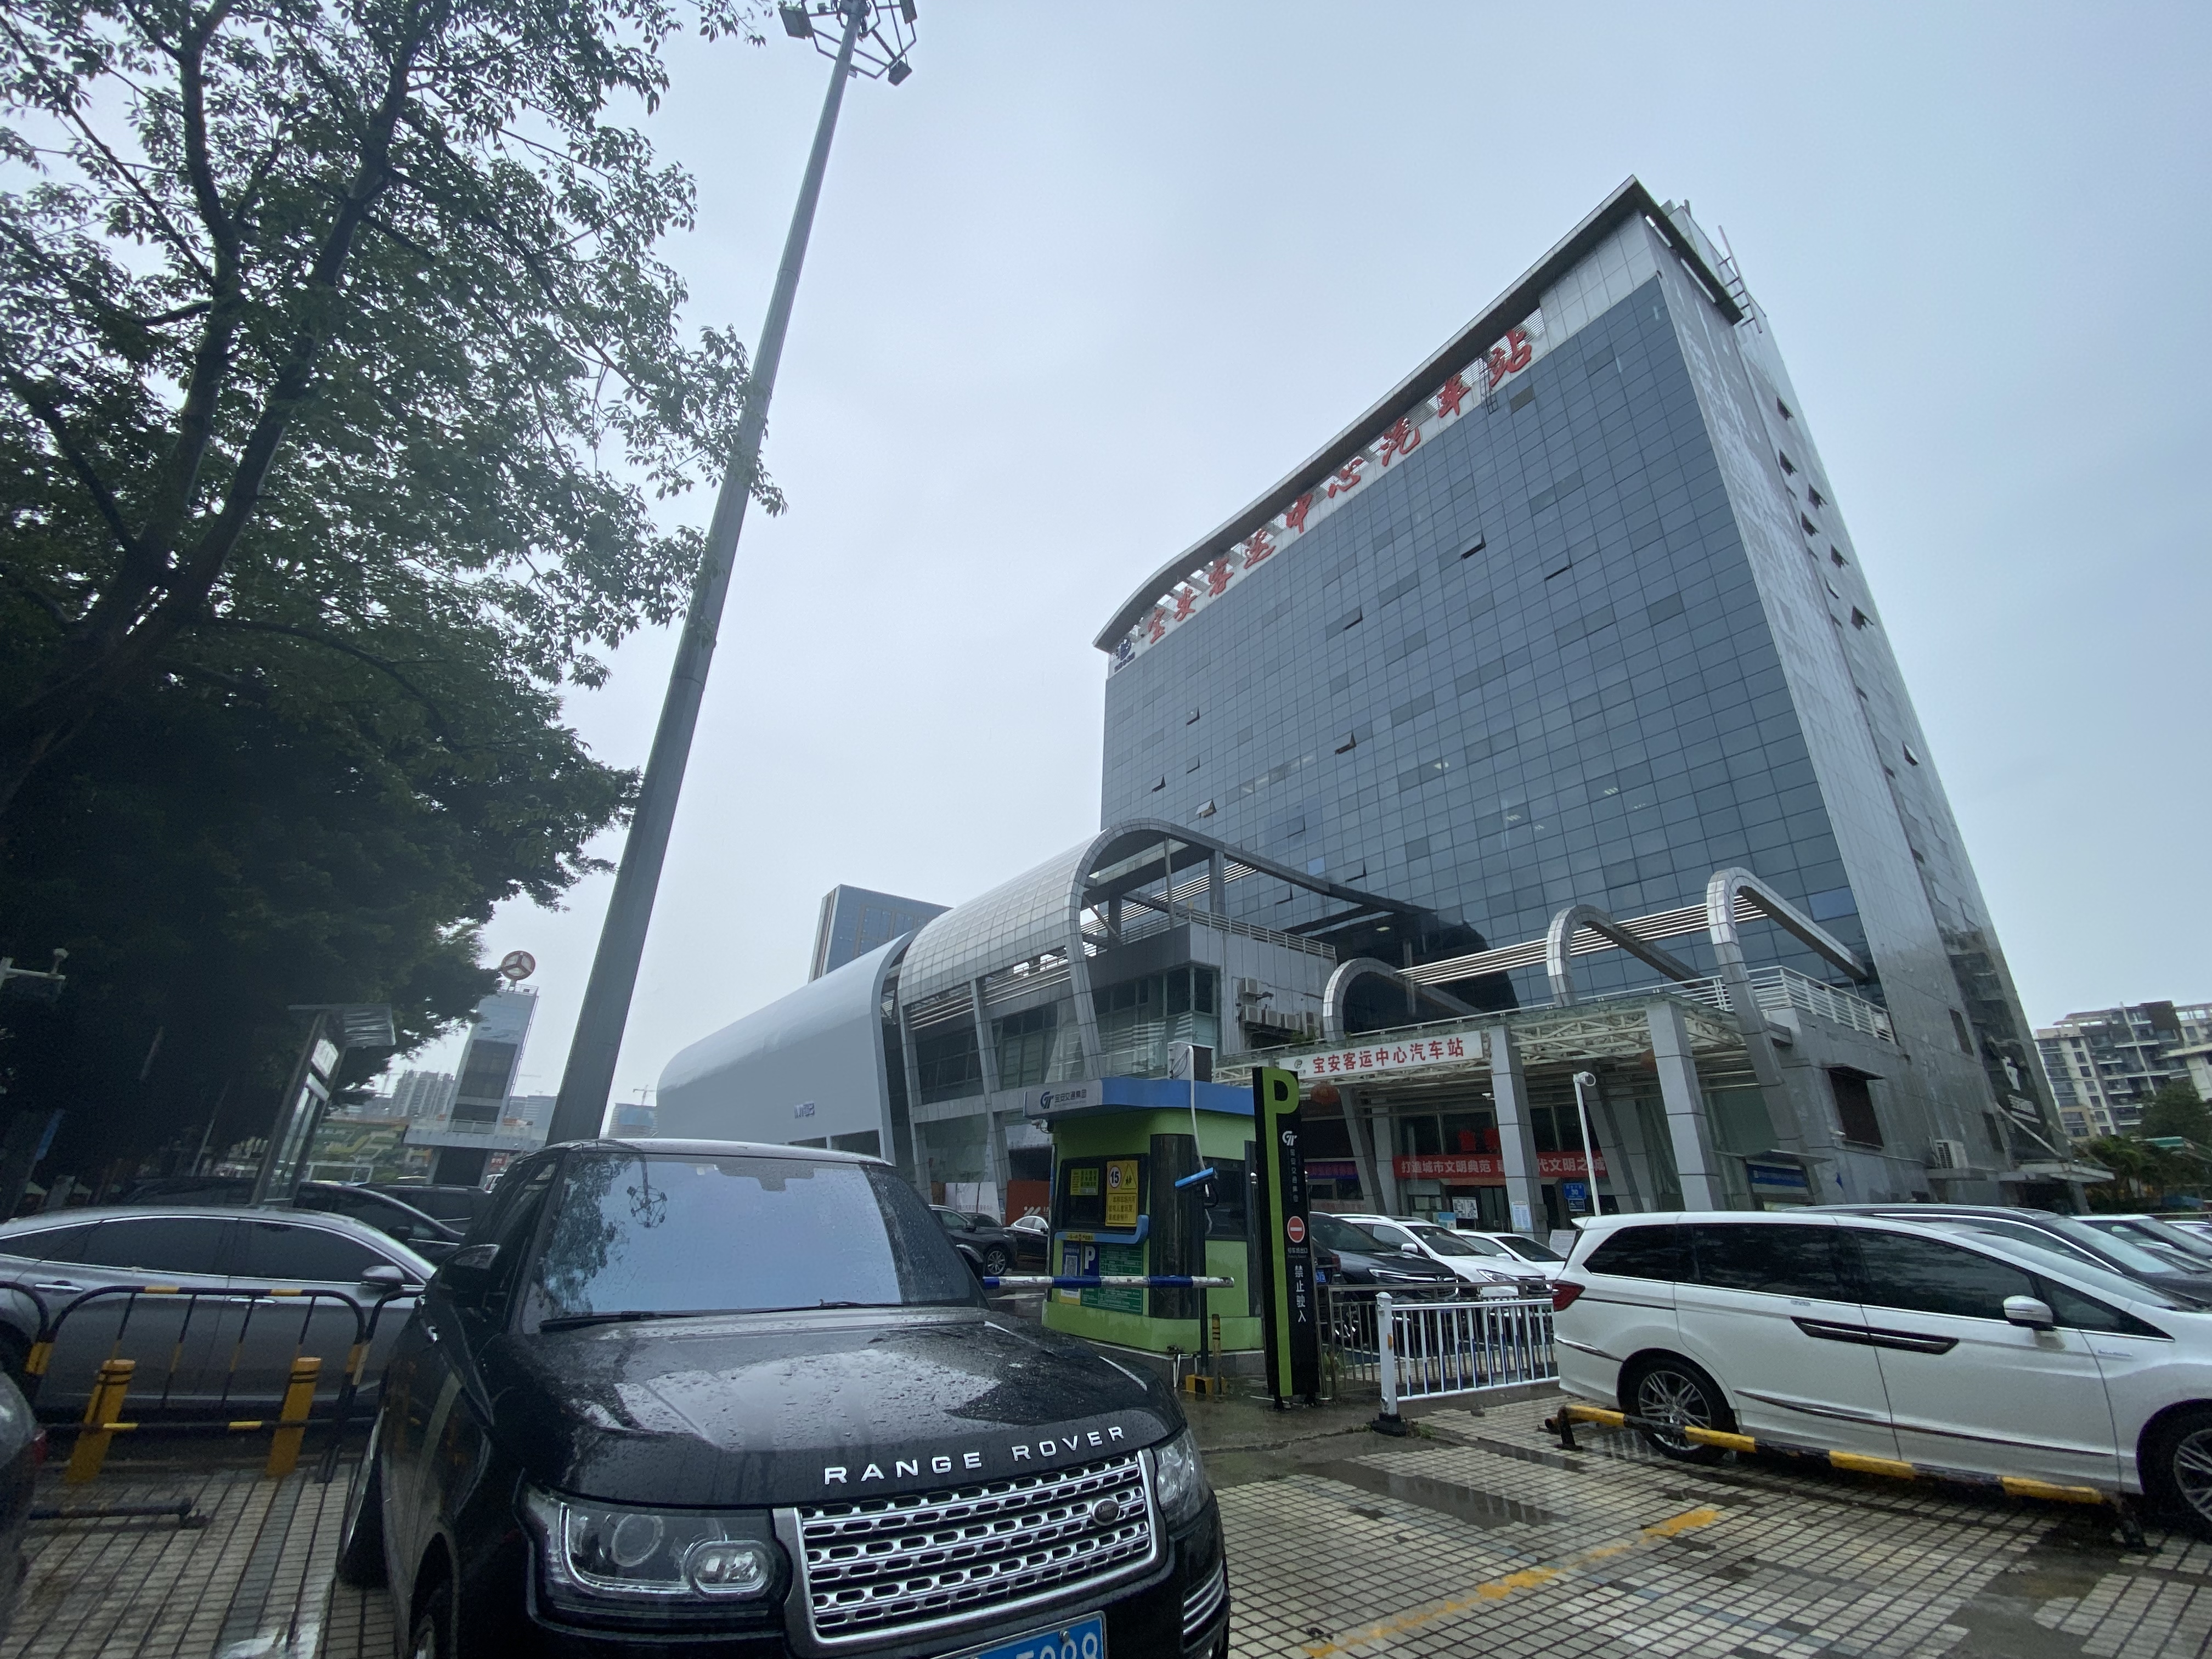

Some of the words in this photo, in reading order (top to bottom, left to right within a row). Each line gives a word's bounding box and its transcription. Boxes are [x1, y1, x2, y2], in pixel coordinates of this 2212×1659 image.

[1312, 1037, 1464, 1074] 宝安客运中心汽车站
[1110, 1171, 1119, 1184] 15
[1402, 1159, 1491, 1174] 打造城市文明典范
[1085, 1246, 1096, 1270] P
[1294, 1265, 1306, 1323] 禁止驶入
[824, 1452, 982, 1485] RANGE
[1012, 1426, 1125, 1462] ROVER
